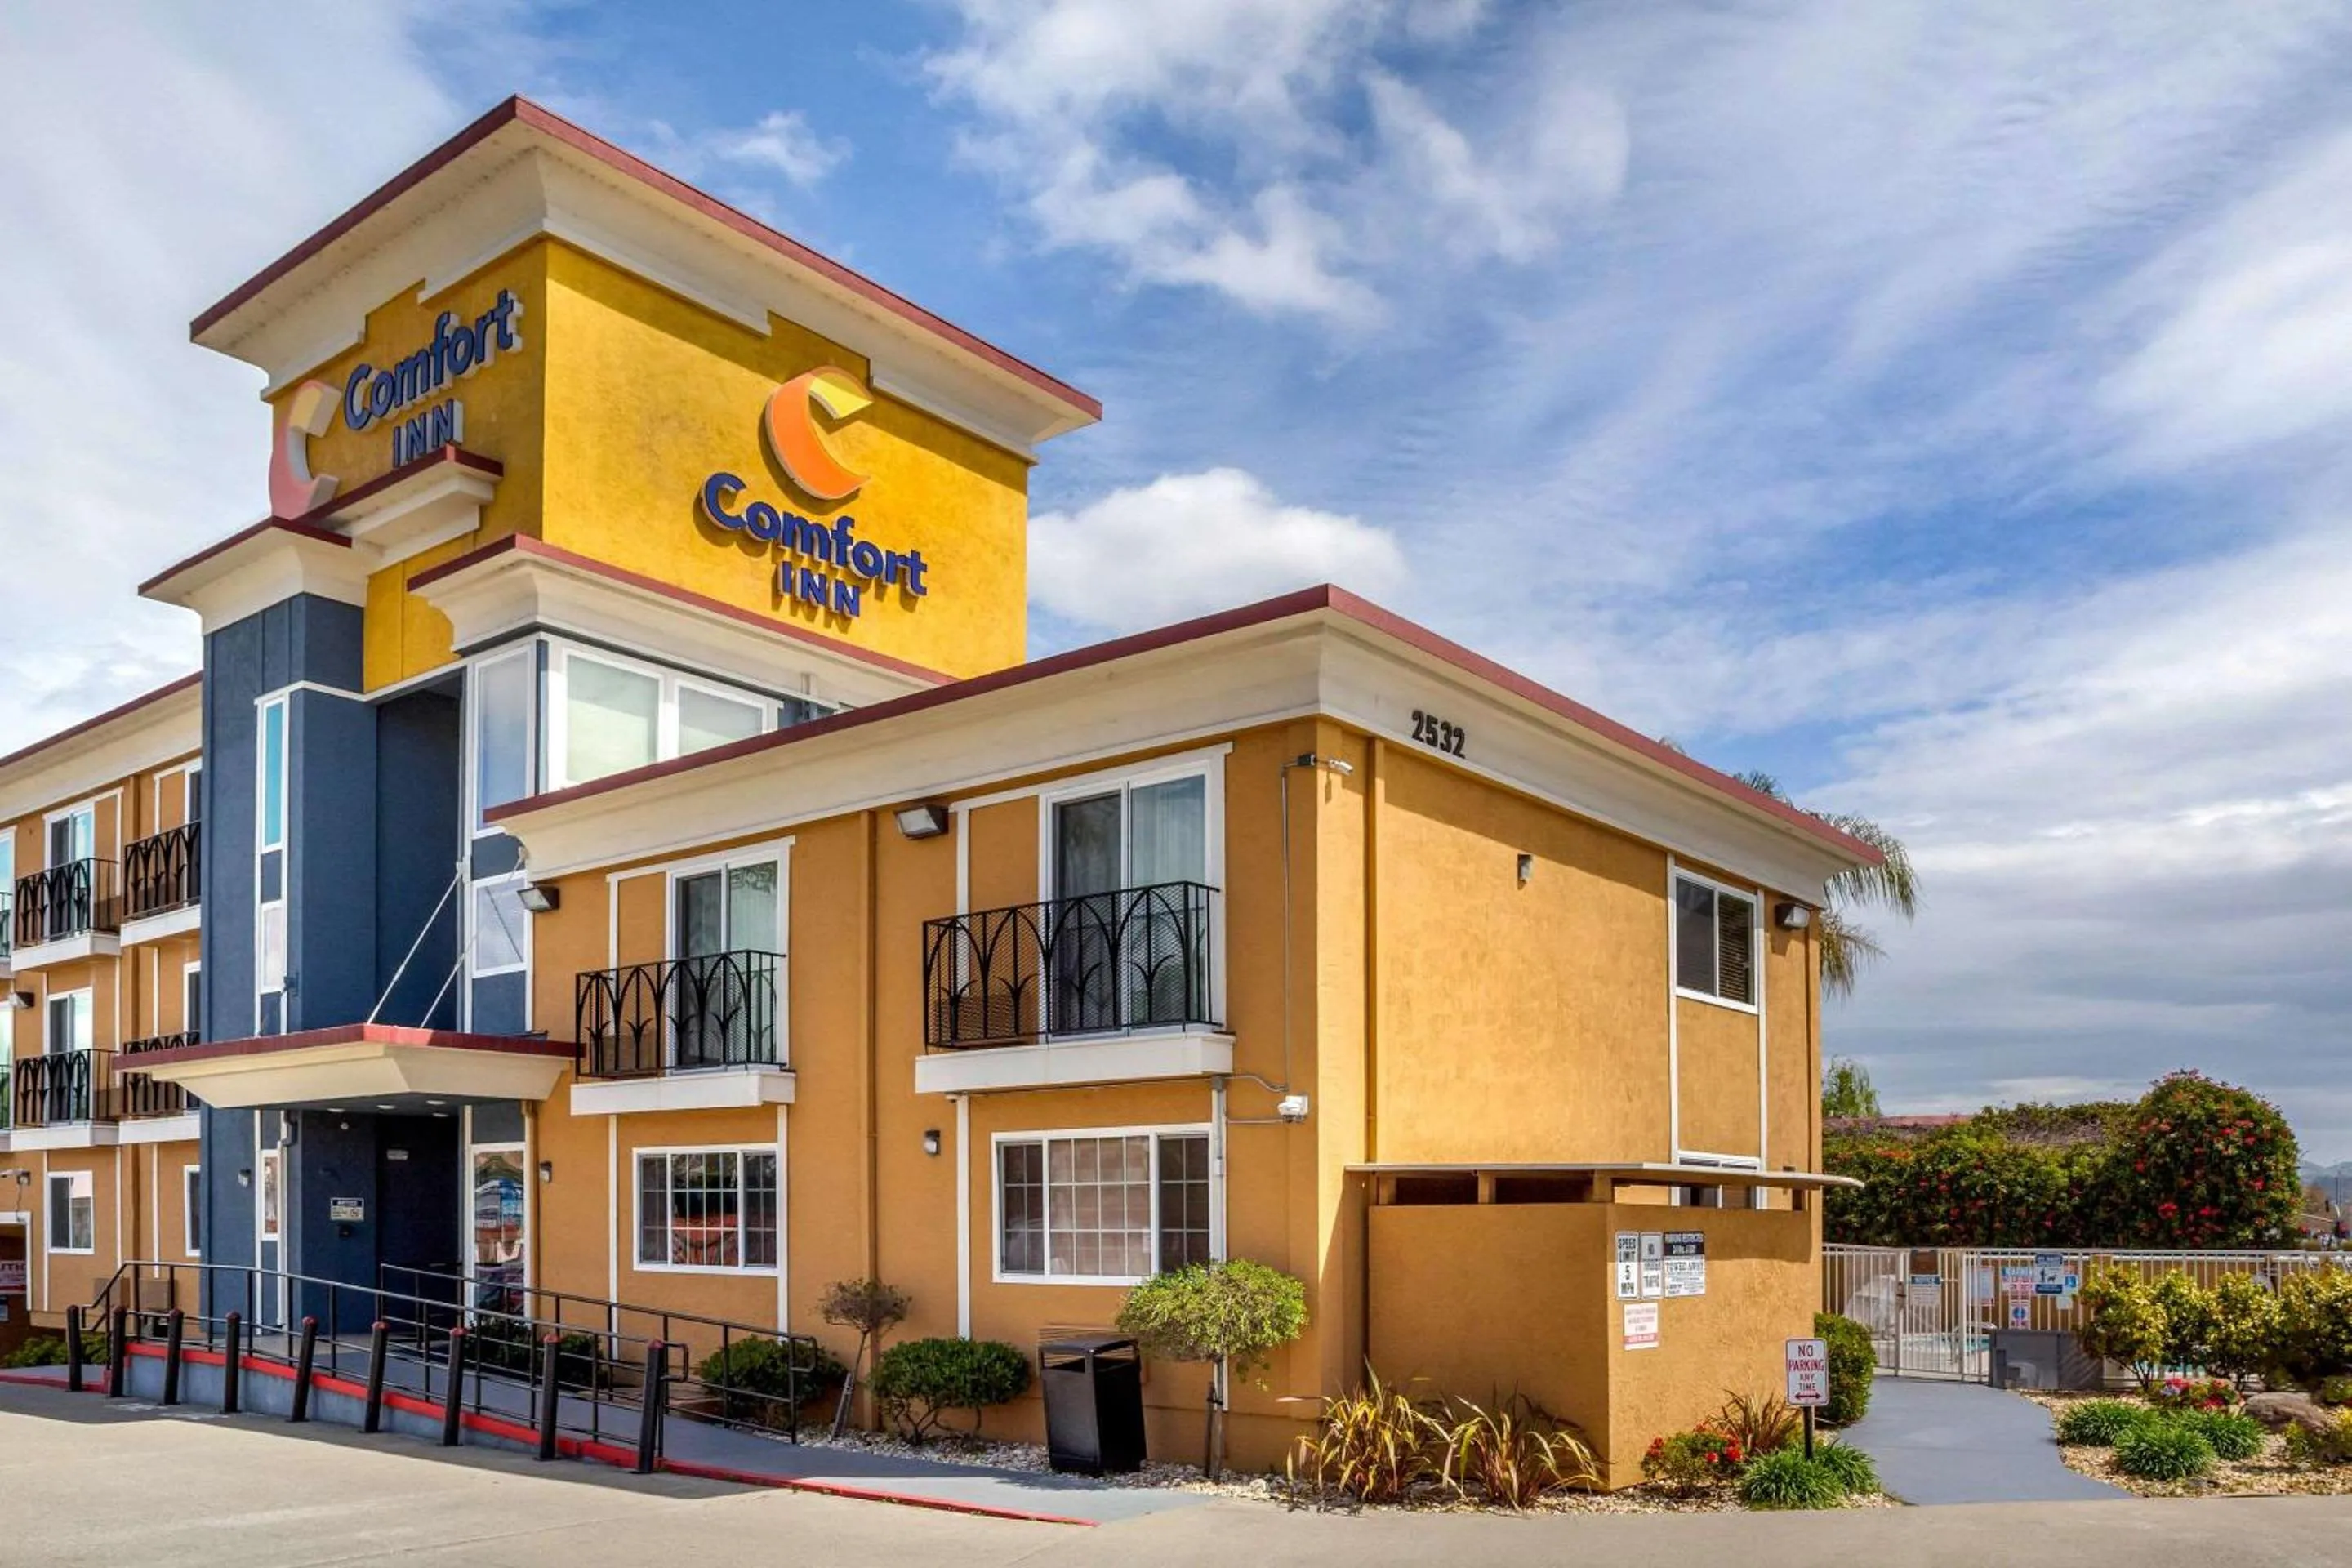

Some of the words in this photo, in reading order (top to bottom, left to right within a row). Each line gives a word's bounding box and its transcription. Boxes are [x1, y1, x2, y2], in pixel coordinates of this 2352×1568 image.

[345, 289, 517, 430] Comfort
[393, 399, 459, 468] INN
[702, 471, 928, 596] Comfort
[778, 560, 861, 617] INN
[1411, 709, 1466, 760] 2532
[1618, 1237, 1637, 1250] SPEED
[1625, 1264, 1631, 1281] 5
[1798, 1344, 1814, 1357] NO
[1788, 1359, 1824, 1372] PARKING
[1799, 1373, 1815, 1382] ANY
[1797, 1382, 1816, 1392] TIME
